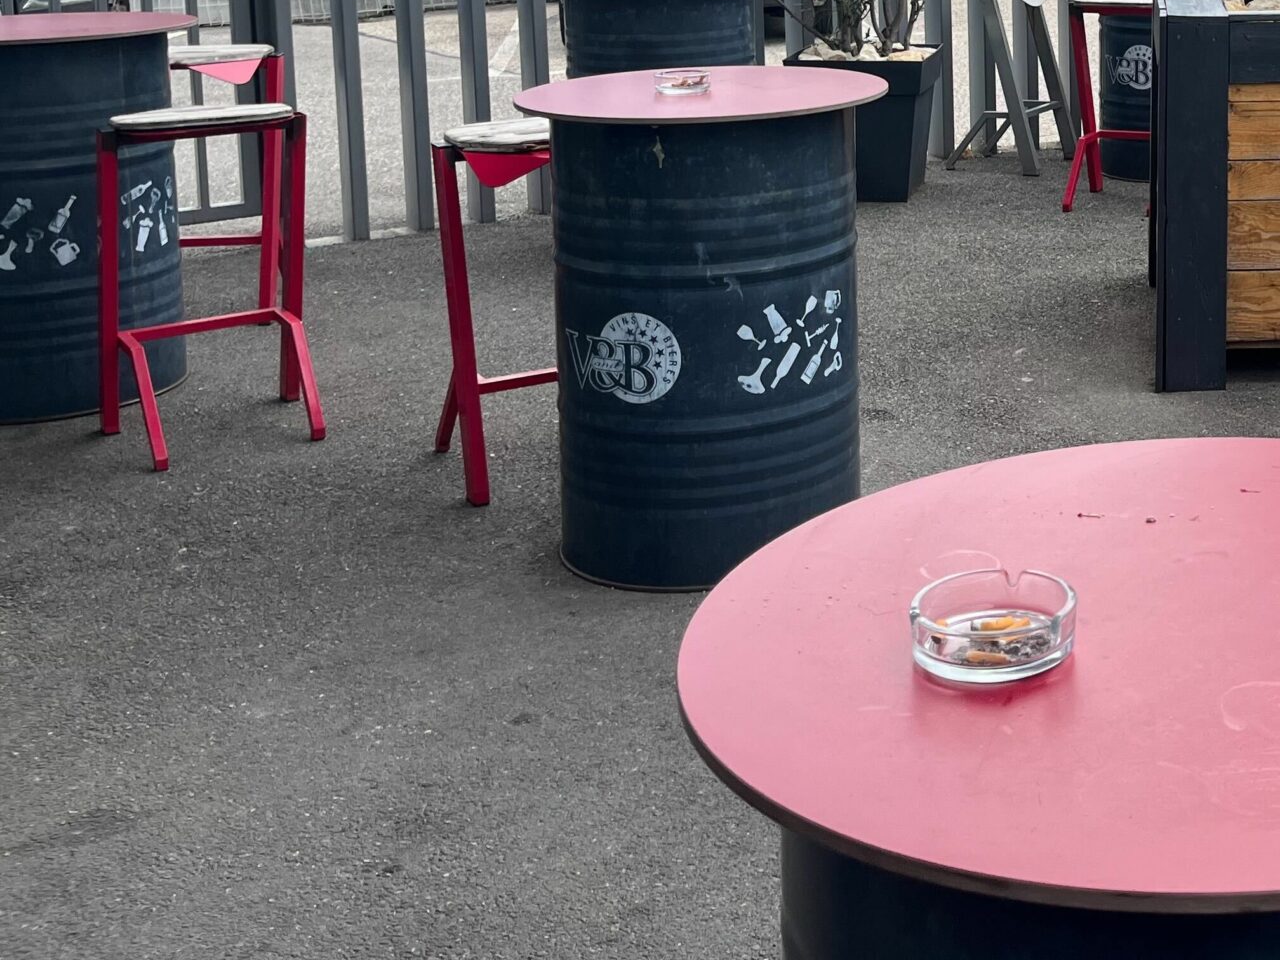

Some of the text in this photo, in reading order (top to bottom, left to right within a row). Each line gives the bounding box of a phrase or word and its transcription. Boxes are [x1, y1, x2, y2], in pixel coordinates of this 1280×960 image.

[1105, 54, 1150, 86] V&B
[565, 328, 657, 396] V&B
[610, 315, 678, 384] VINS ET BIERES
